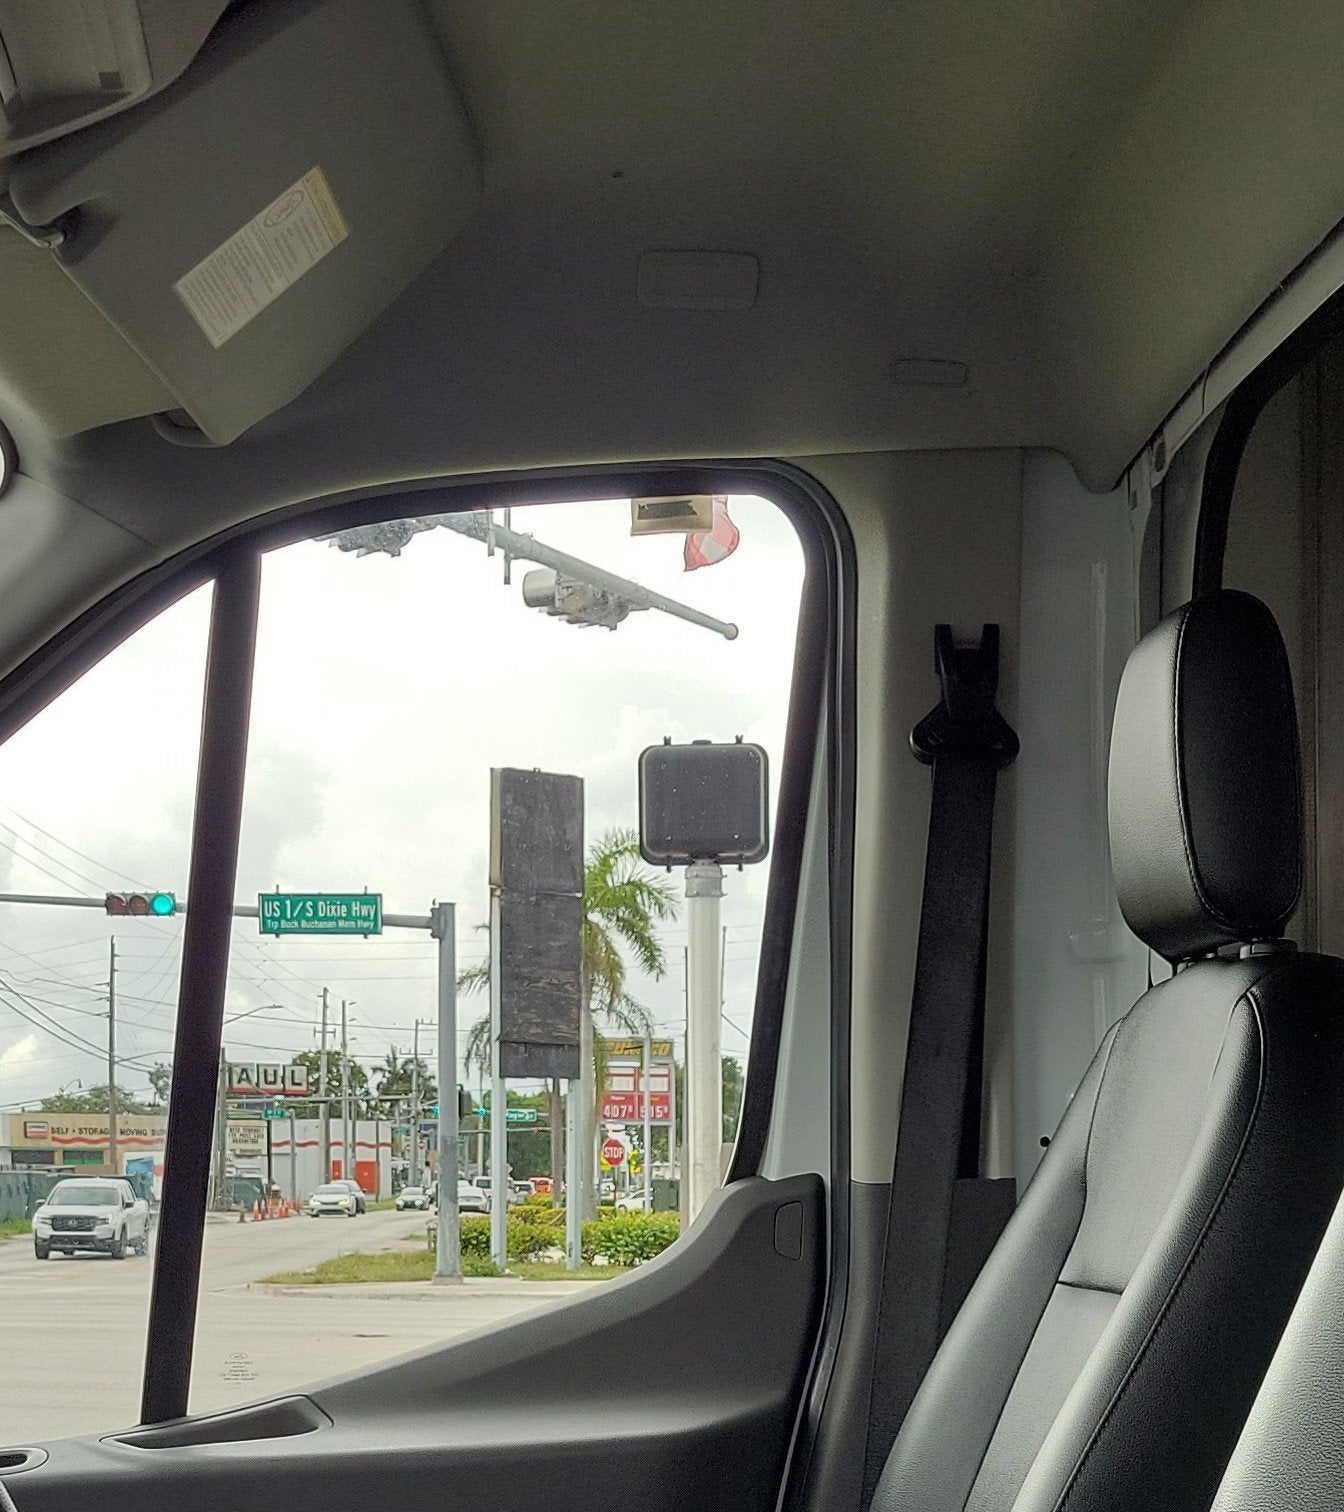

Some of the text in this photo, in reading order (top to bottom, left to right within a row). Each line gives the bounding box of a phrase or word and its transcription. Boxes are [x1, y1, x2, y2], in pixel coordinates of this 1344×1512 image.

[264, 901, 281, 917] US
[318, 901, 347, 917] Dixie
[352, 901, 375, 919] Hwy
[78, 1127, 110, 1135] STORAG
[604, 1146, 623, 1159] STOP
